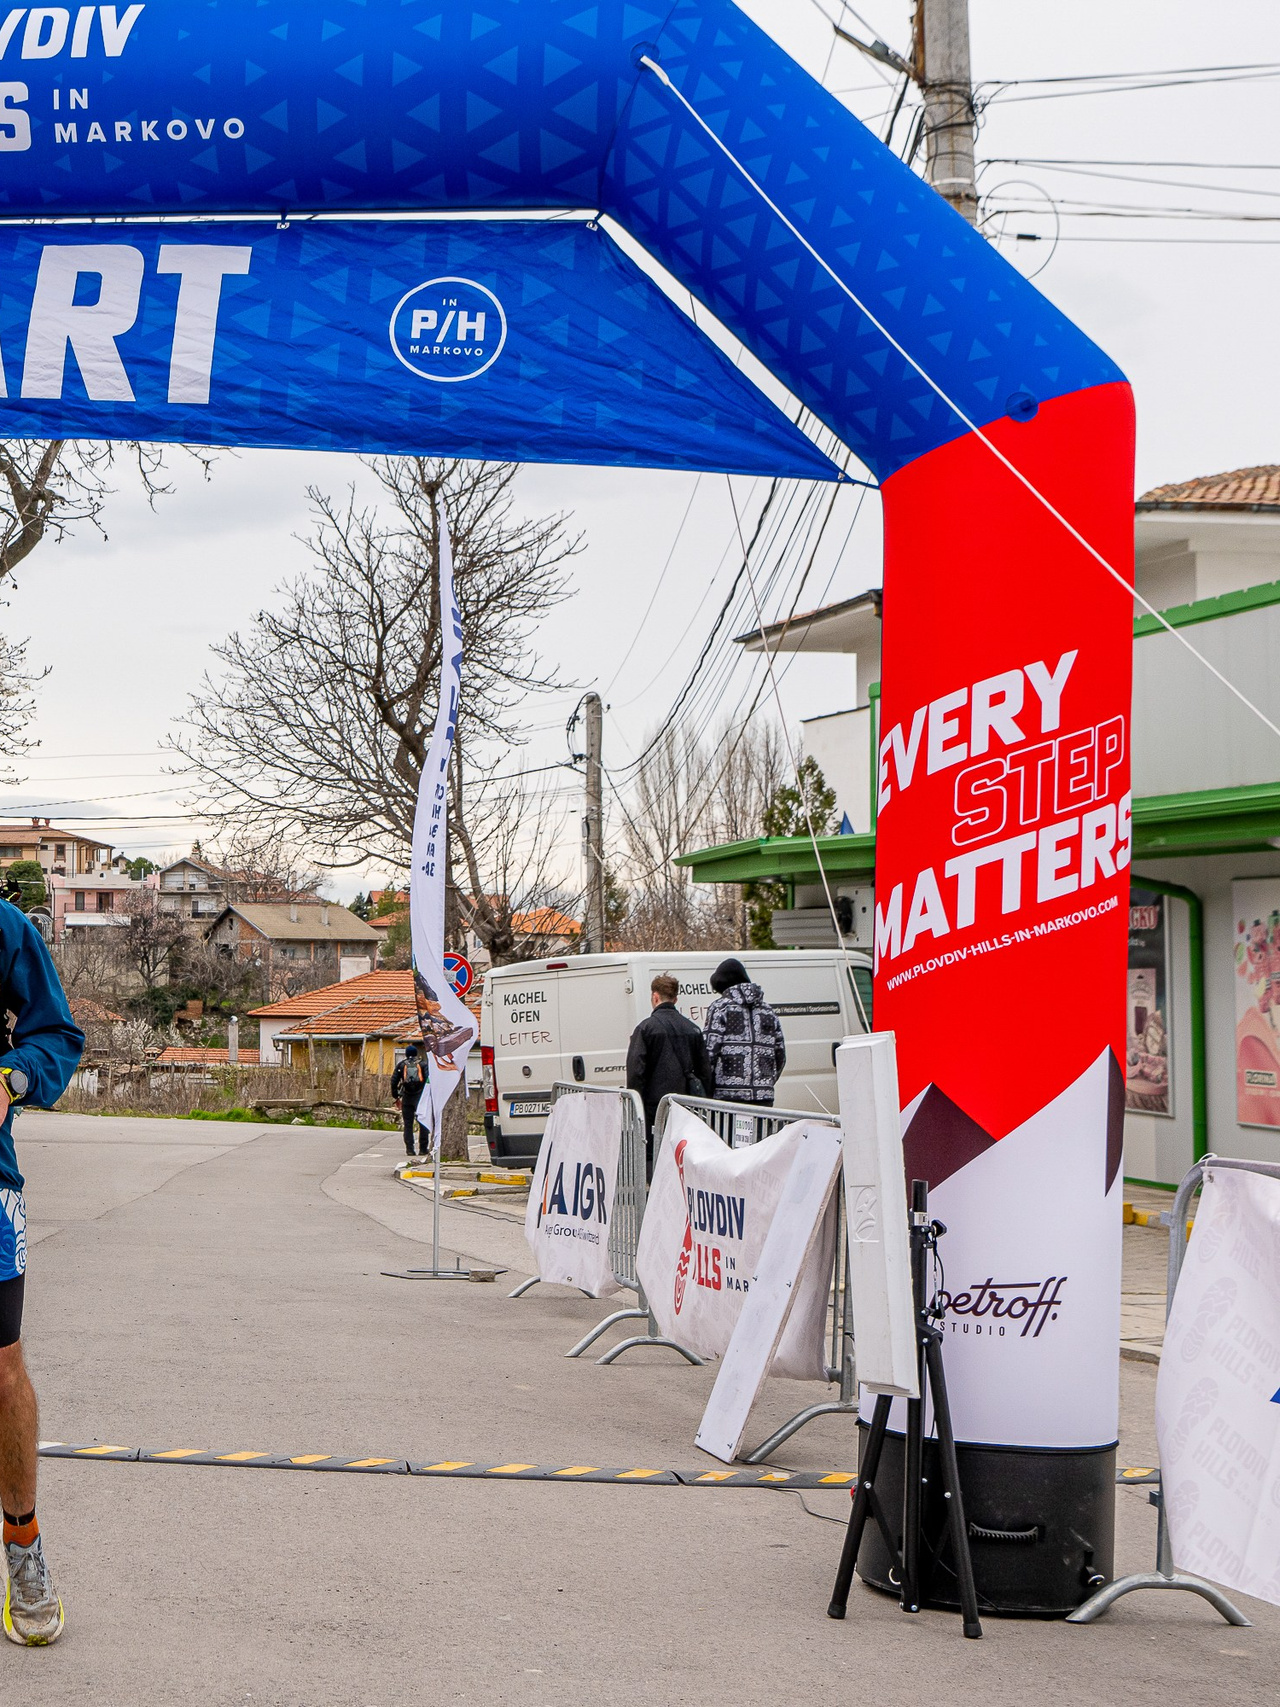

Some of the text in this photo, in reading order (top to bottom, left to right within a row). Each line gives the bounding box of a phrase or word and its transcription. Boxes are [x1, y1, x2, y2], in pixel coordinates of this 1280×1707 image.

[53, 88, 89, 110] IN
[54, 117, 245, 144] MARKOVO
[443, 298, 457, 306] IN
[411, 309, 486, 343] P/H
[410, 345, 483, 356] MARKOVO
[877, 649, 1078, 817] EVERY
[952, 715, 1125, 846] STEP
[874, 788, 1131, 978] MATTERS
[887, 895, 1118, 991] WWW.PLOVDIV-HILLS-IN-MARKOVO.COM
[677, 984, 718, 995] ACHEL
[504, 991, 547, 1006] KACHEL
[510, 1009, 540, 1024] ÖFEN
[500, 1031, 552, 1047] LEITER
[687, 1186, 745, 1241] PLOVDIV
[726, 1256, 736, 1271] IN
[726, 1277, 749, 1293] MAR
[939, 1321, 1005, 1337] STUDIO
